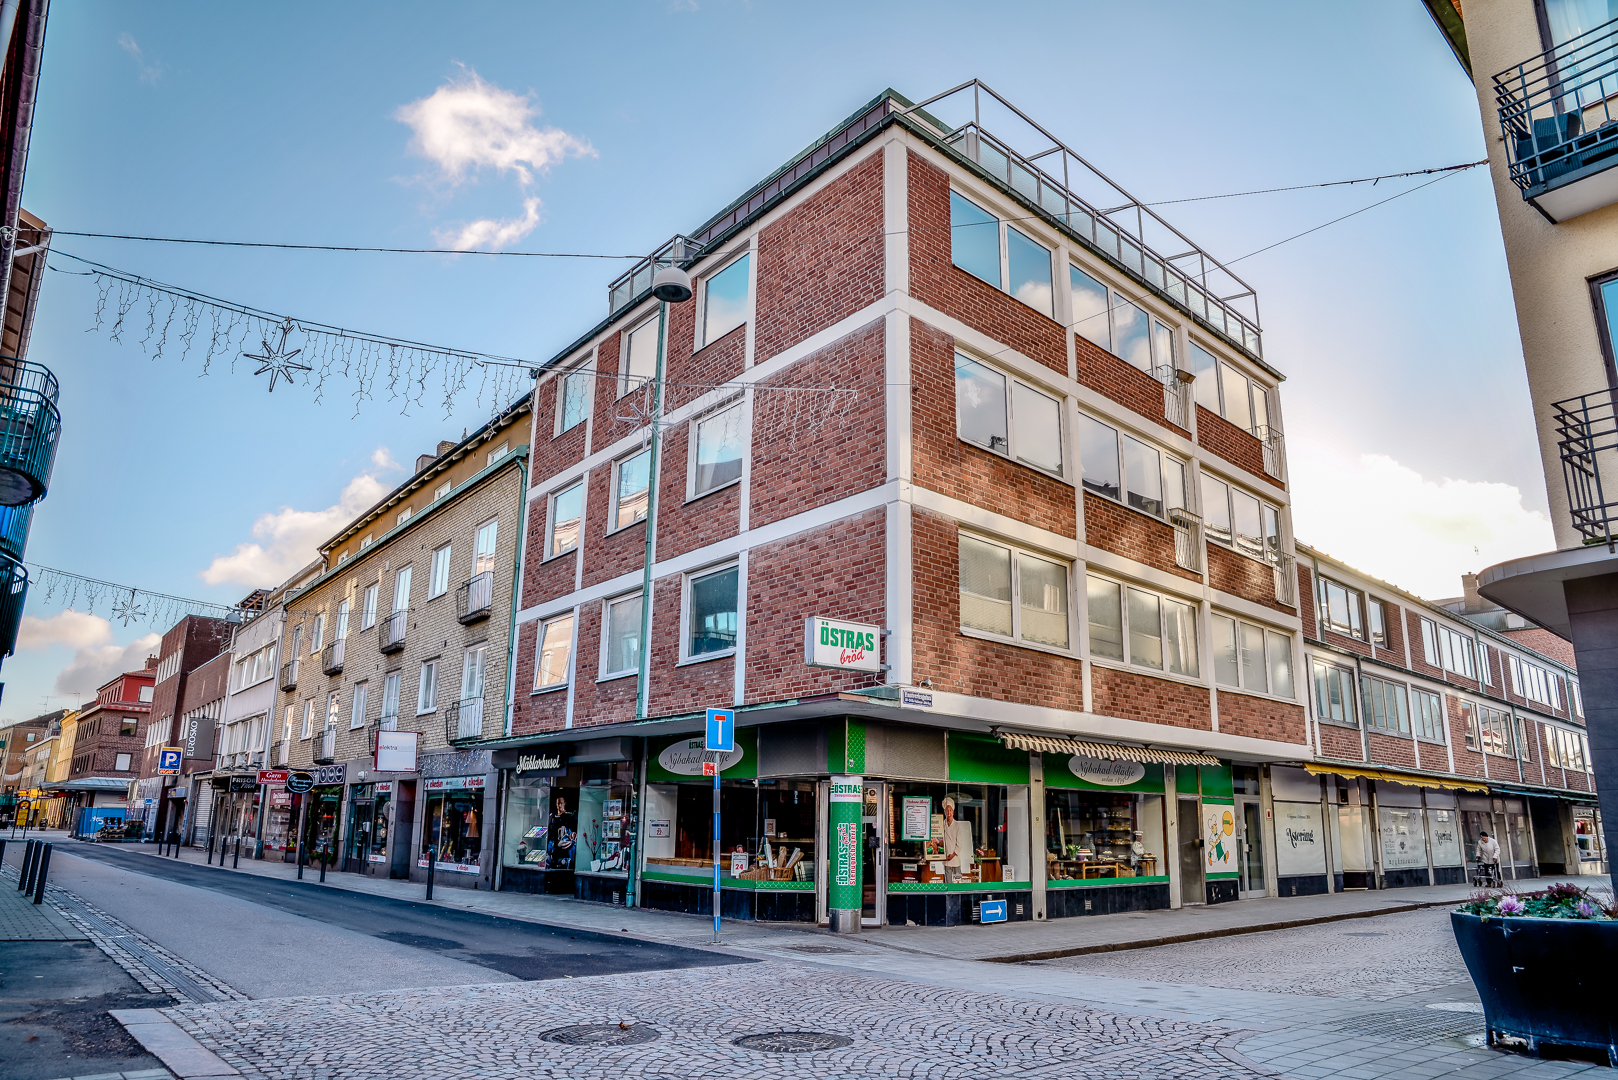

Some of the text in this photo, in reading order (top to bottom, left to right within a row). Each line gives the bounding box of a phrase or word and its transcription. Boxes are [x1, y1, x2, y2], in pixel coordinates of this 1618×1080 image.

[820, 621, 874, 652] ÖSTRAS
[840, 645, 865, 665] bröd
[186, 720, 198, 757] EUROSKO
[165, 753, 178, 767] P
[665, 750, 703, 769] Nybakad
[1075, 760, 1135, 780] Nybakad Glädje
[834, 782, 861, 794] ÖSTRAS
[836, 847, 849, 882] ÖSTRAS
